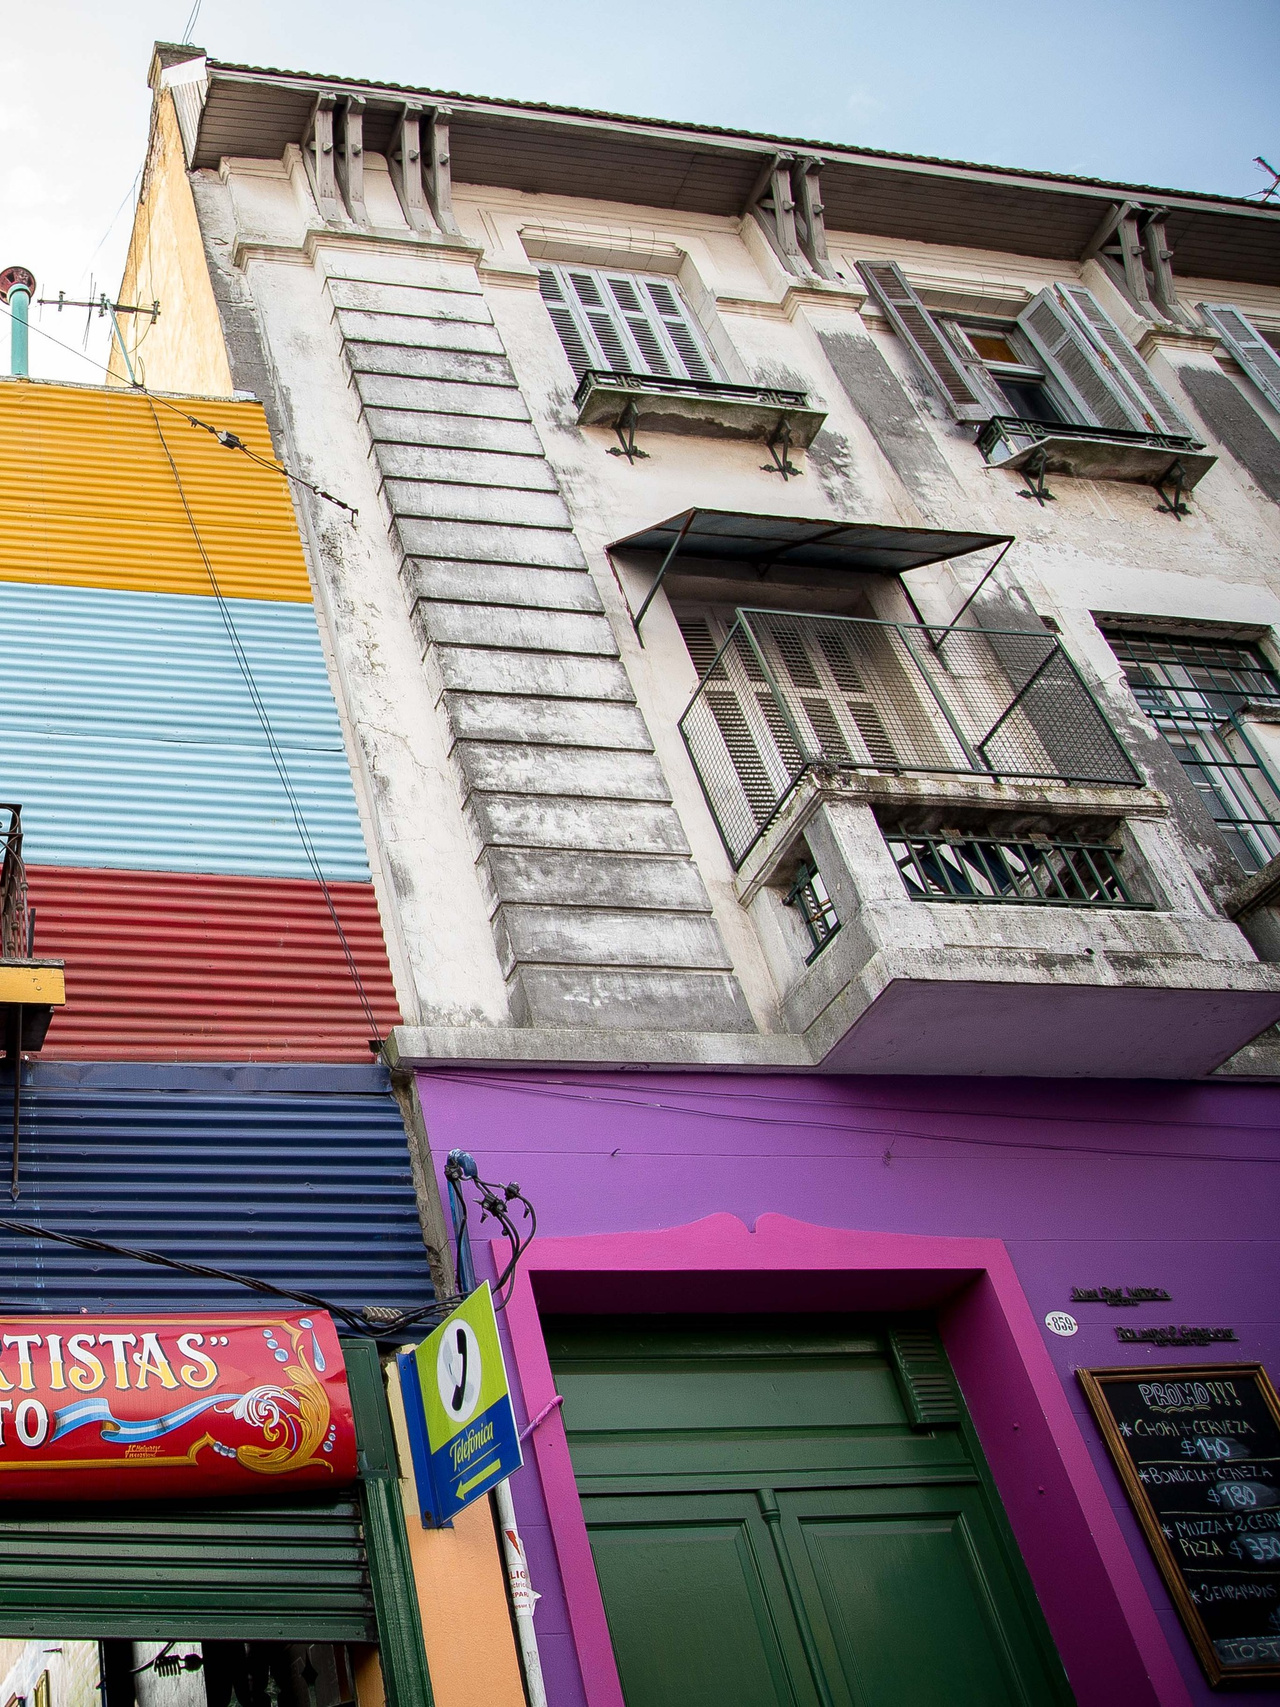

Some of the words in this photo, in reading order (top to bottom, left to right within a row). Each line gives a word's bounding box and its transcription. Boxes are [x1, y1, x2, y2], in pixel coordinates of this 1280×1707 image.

[1051, 1316, 1074, 1331] 859
[1138, 1381, 1242, 1407] PROMO!!!
[1180, 1437, 1232, 1460] $140
[1175, 1520, 1226, 1538] MUZZA
